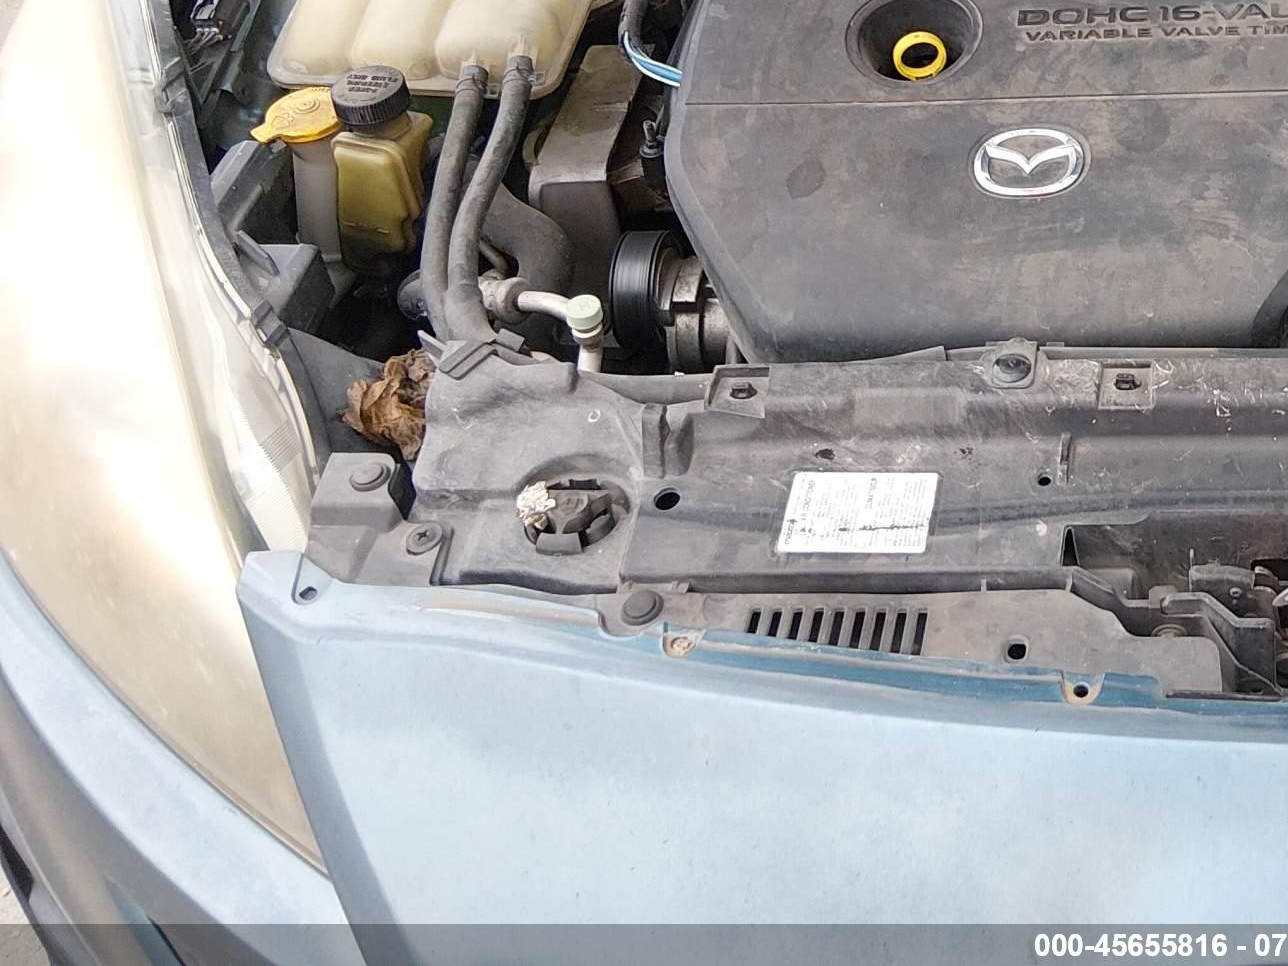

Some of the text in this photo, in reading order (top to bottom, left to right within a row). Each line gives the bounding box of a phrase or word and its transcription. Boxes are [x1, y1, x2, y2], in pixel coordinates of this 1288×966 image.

[1017, 6, 1149, 27] DOHC
[1025, 27, 1153, 42] VARIABLE
[1161, 24, 1241, 38] VALVE
